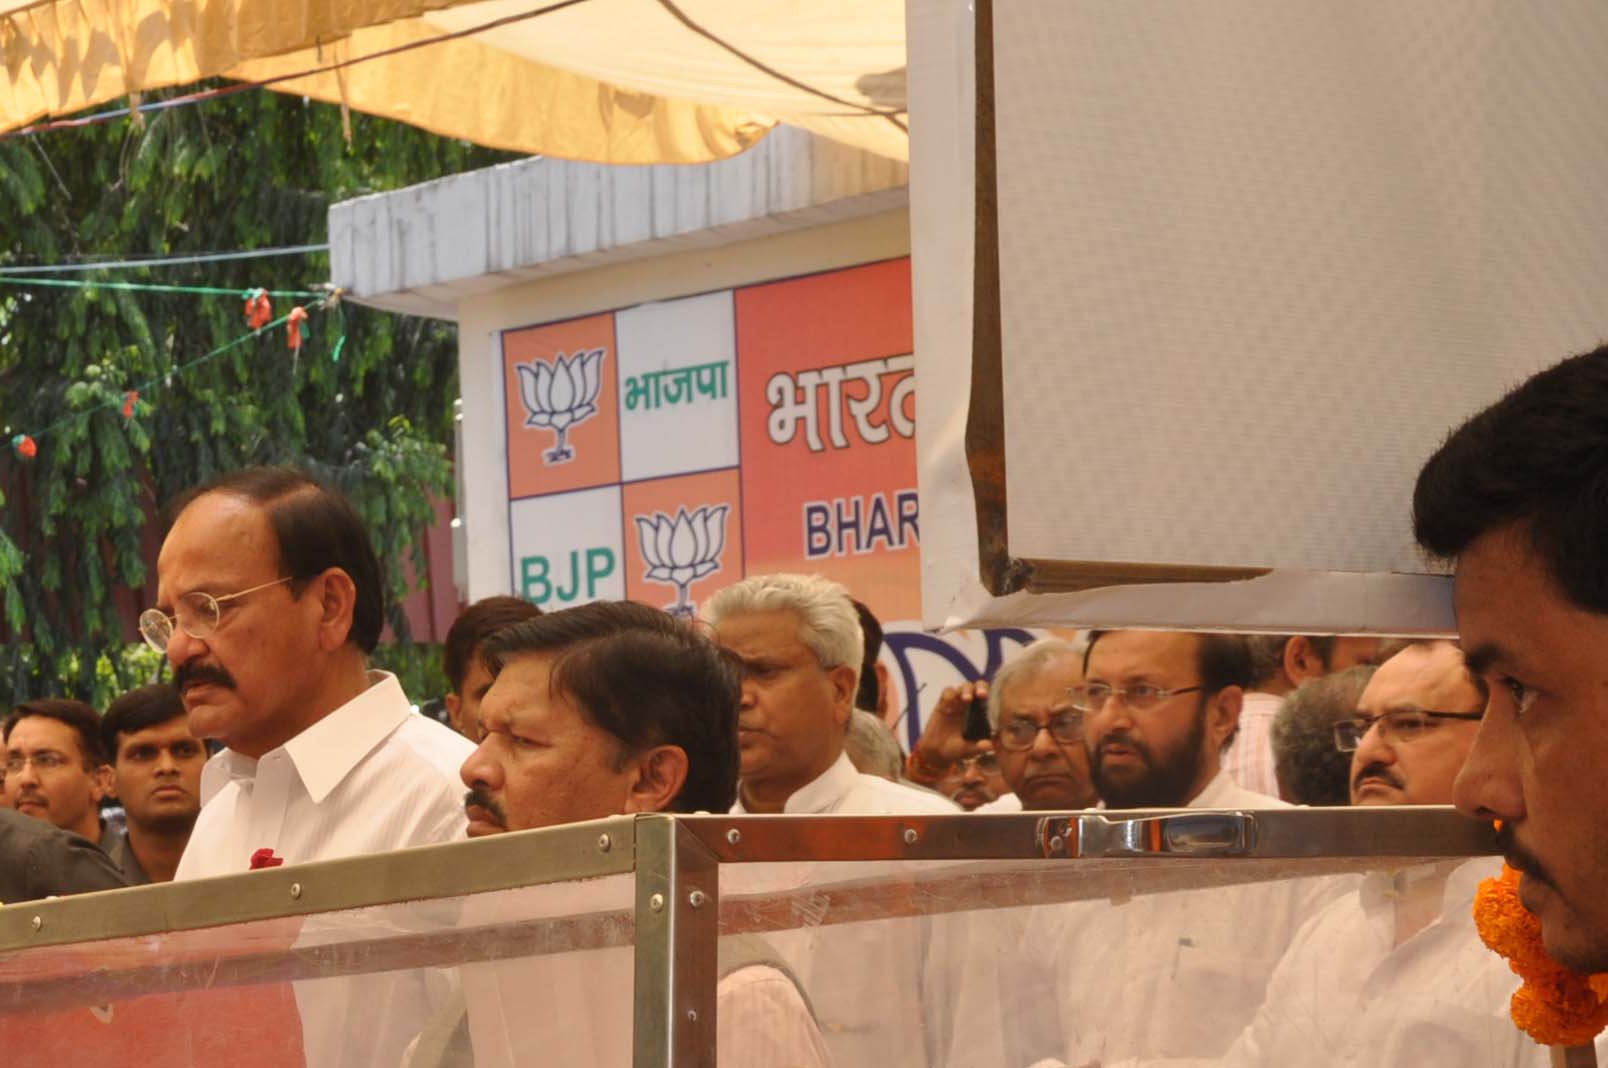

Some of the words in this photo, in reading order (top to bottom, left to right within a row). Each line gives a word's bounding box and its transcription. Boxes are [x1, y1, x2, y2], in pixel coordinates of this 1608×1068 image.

[624, 360, 730, 411] भाजपा
[803, 490, 920, 558] BHAR
[520, 546, 616, 606] BJP
